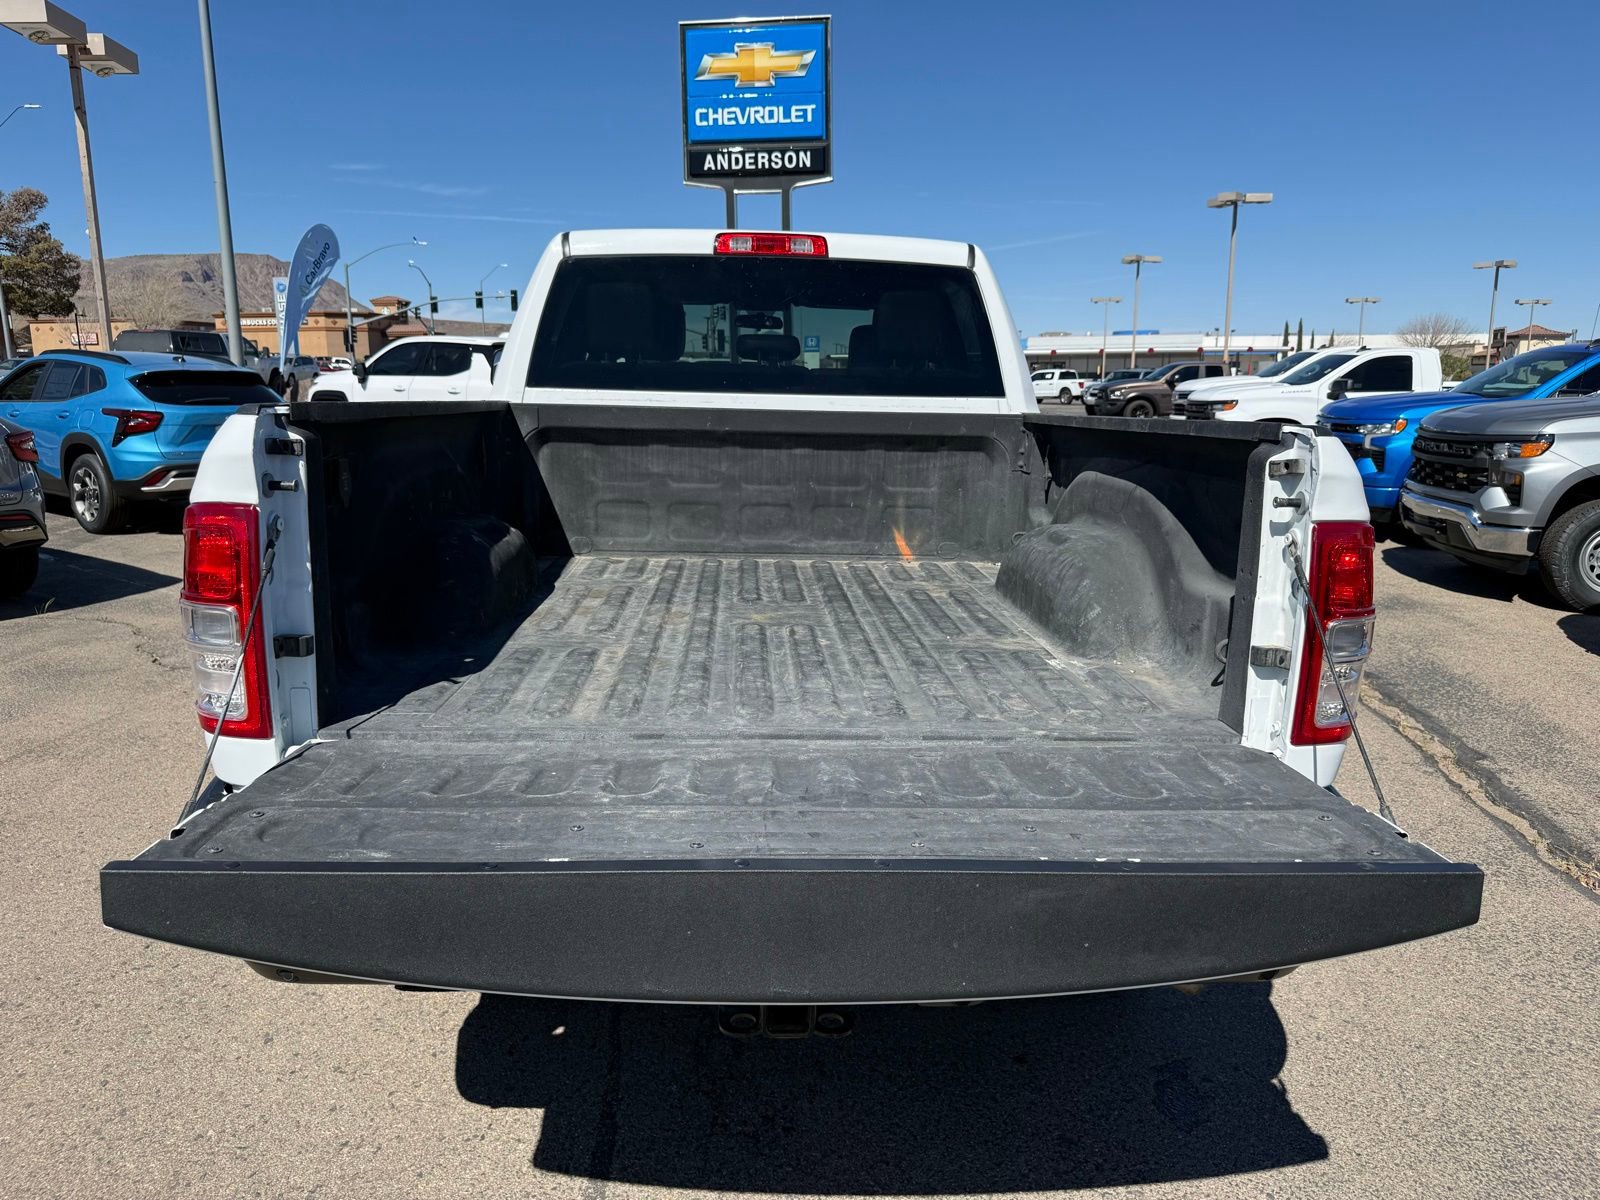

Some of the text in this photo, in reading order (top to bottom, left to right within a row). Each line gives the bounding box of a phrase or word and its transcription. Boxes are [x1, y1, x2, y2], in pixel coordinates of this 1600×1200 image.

[694, 104, 816, 127] CHEVROLET
[703, 150, 811, 171] ANDERSON
[305, 242, 330, 285] CarBravo
